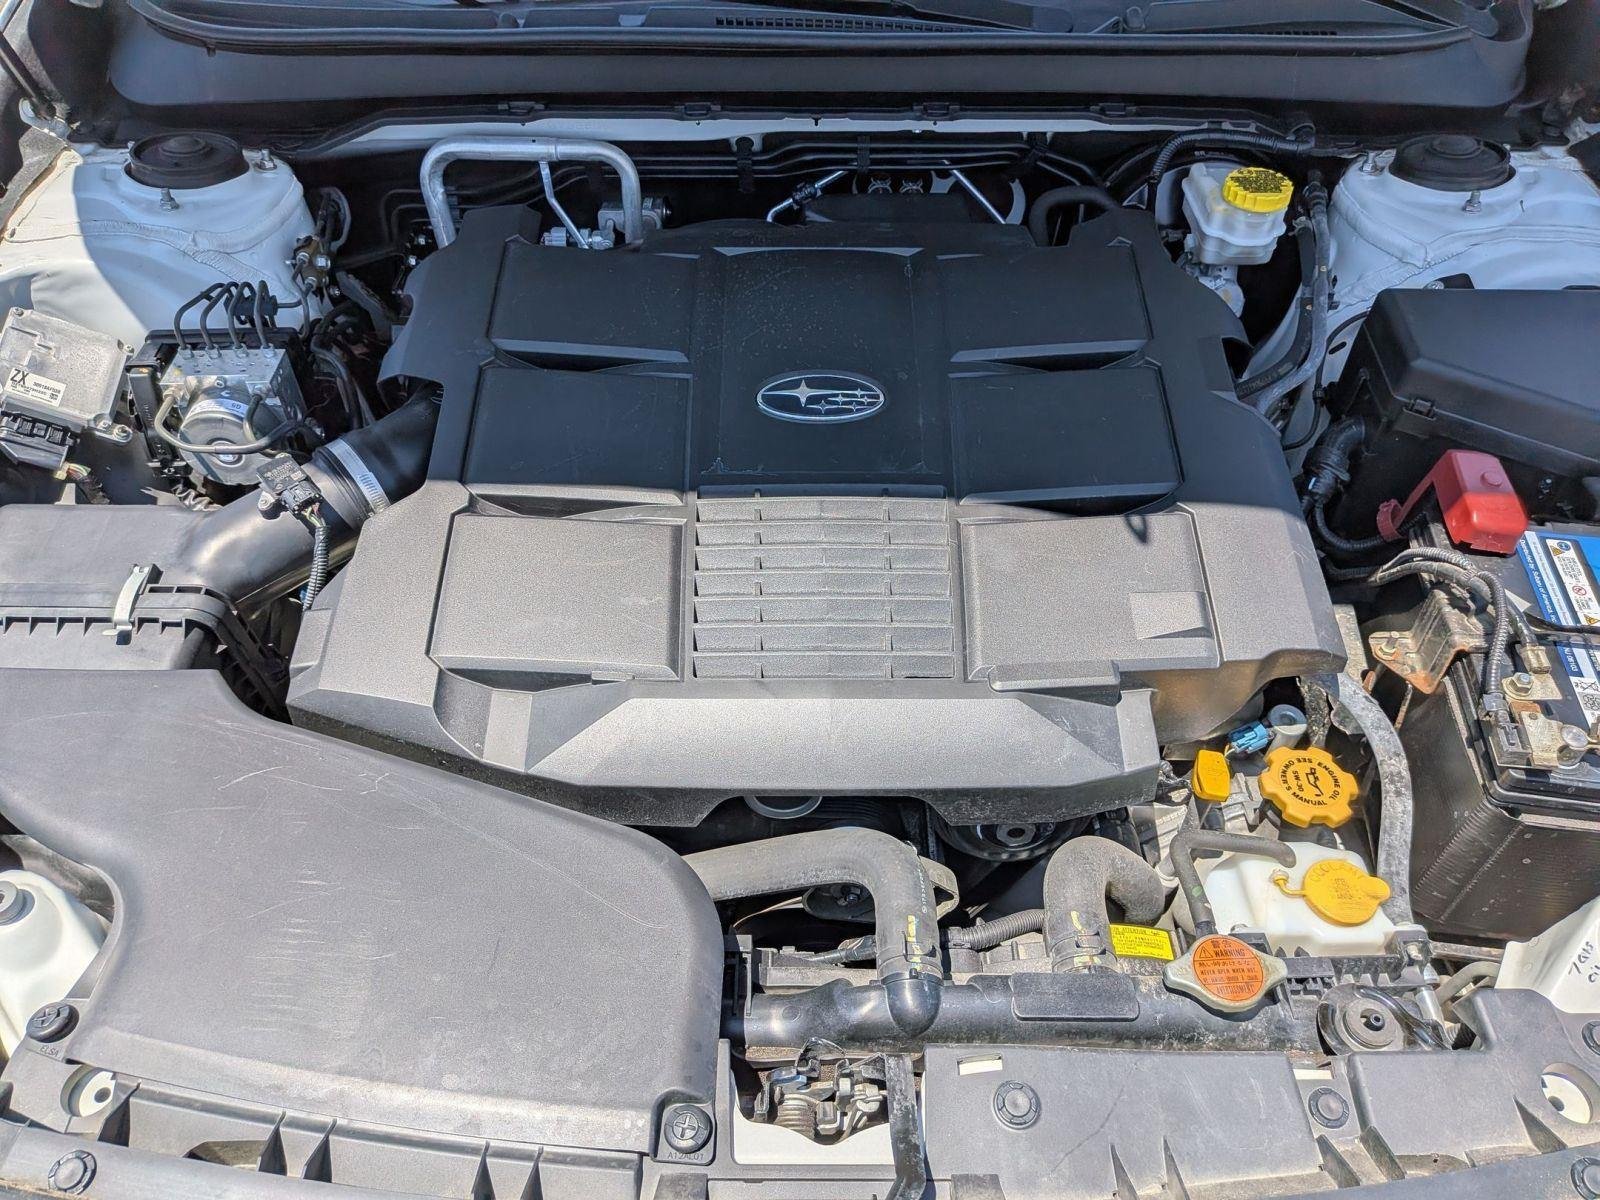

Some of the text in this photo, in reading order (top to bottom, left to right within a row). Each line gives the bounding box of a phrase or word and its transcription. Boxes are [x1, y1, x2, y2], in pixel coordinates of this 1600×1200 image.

[10, 369, 29, 385] ZX
[1317, 762, 1340, 800] ENGINE OIL
[1291, 792, 1327, 806] MANUAL
[1214, 949, 1246, 958] WARNING
